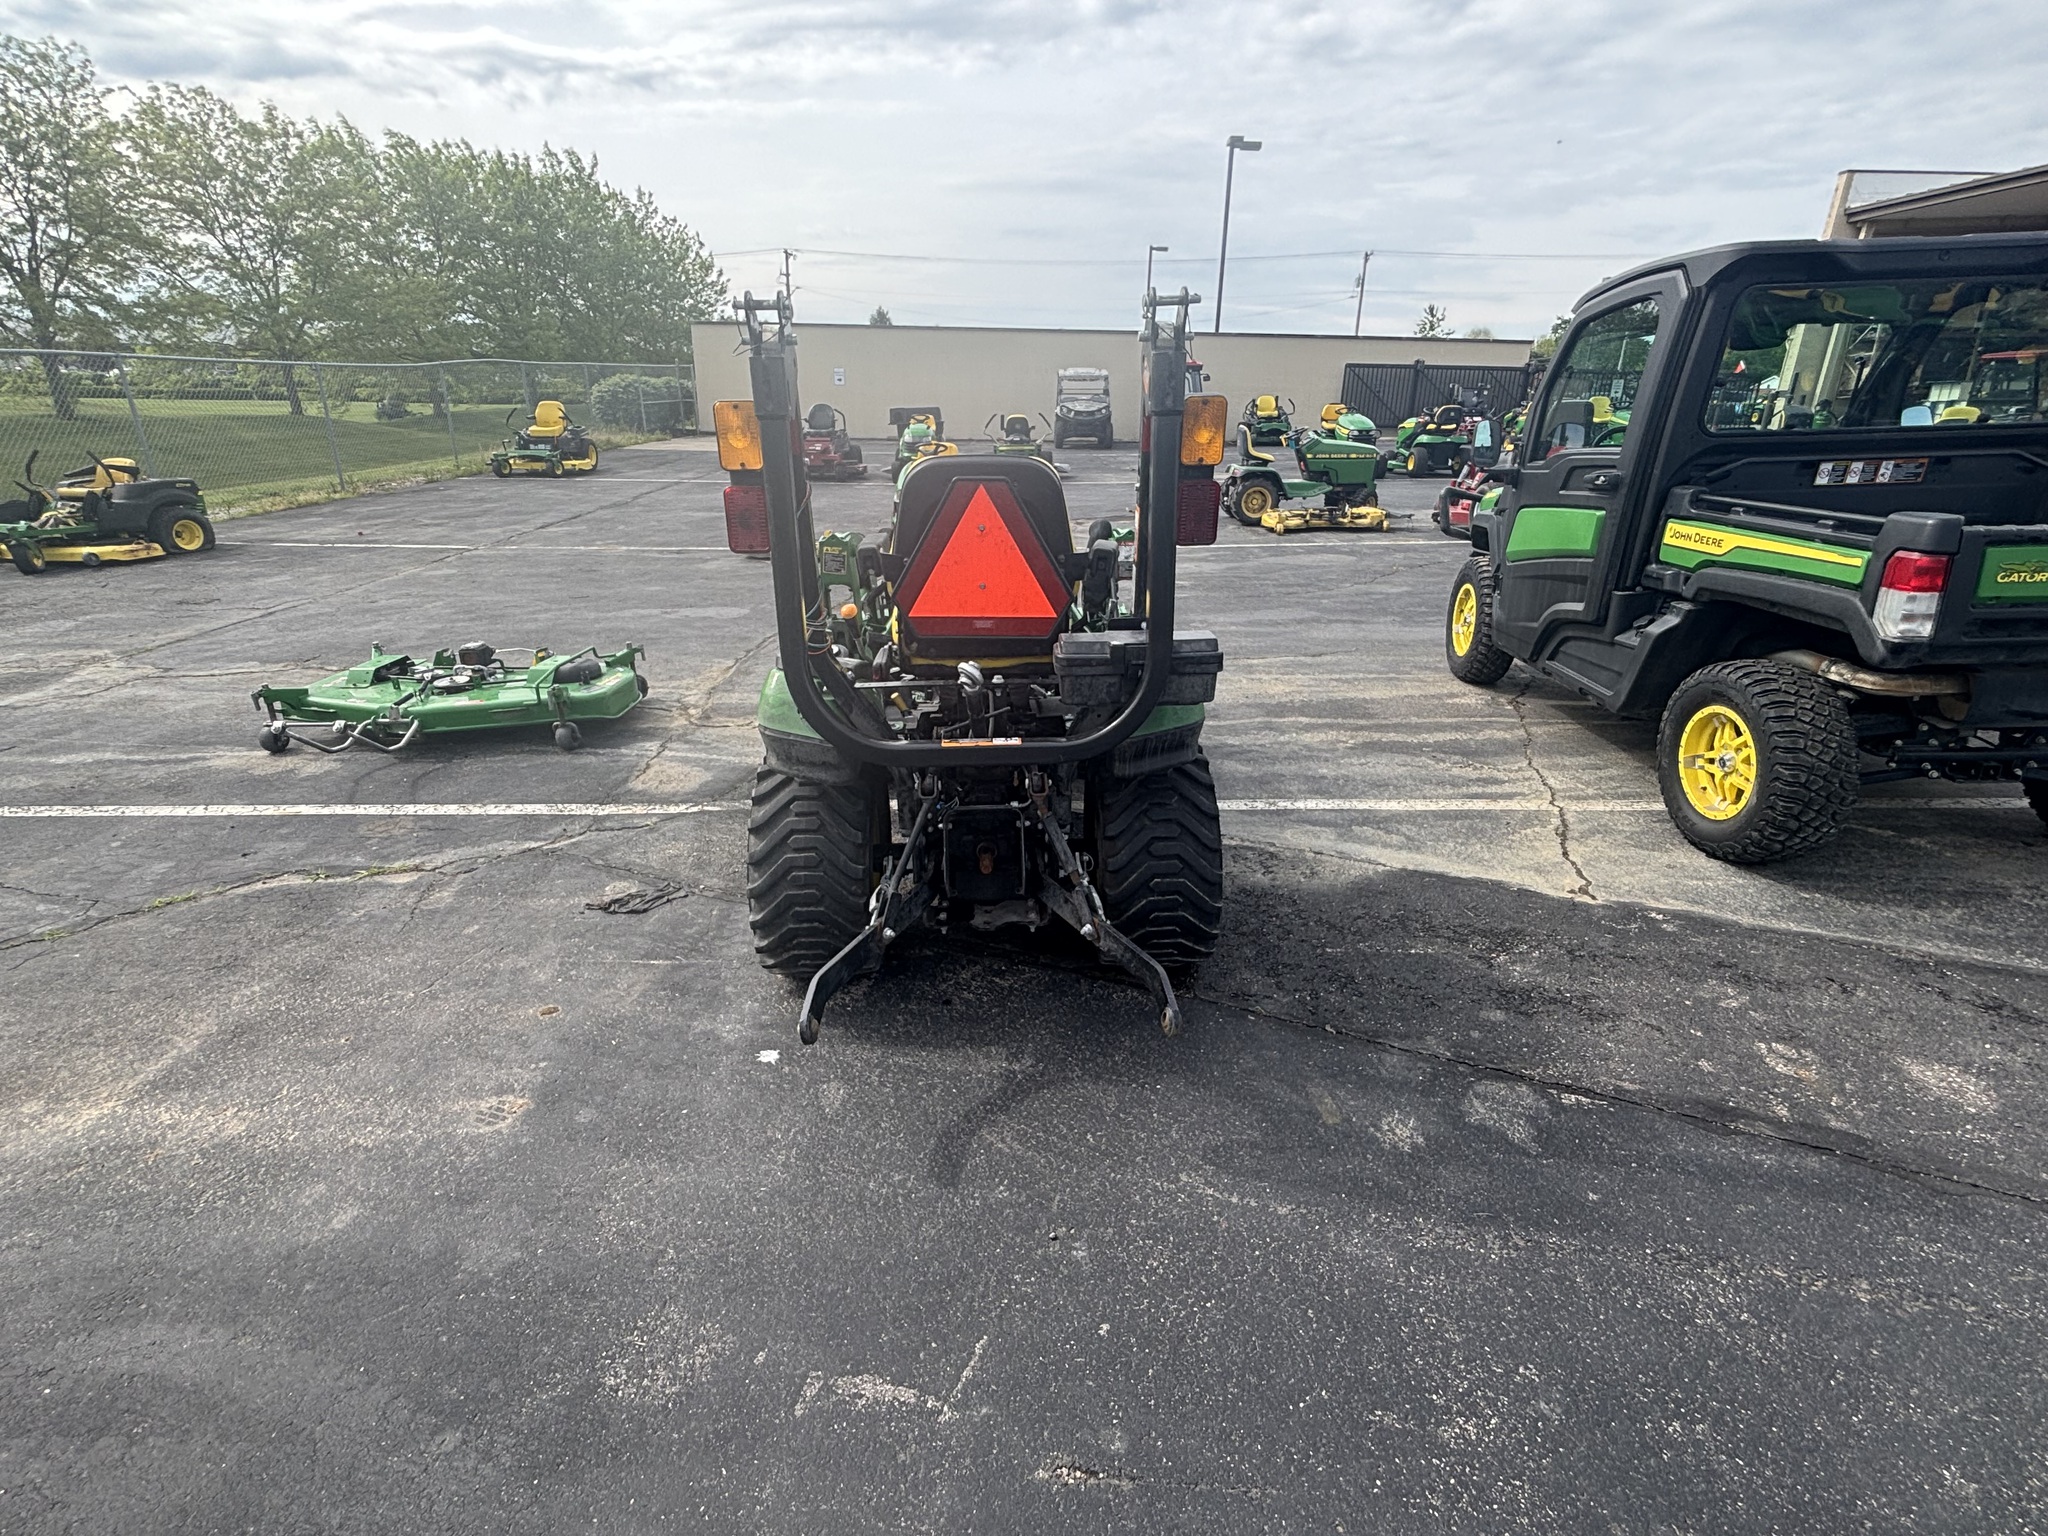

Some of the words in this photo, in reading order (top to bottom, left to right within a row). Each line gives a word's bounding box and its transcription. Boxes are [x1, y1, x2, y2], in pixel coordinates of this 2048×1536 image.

[1669, 528, 1692, 542] JOHN
[1693, 533, 1724, 548] DEERE
[1997, 572, 2048, 583] GATOR
